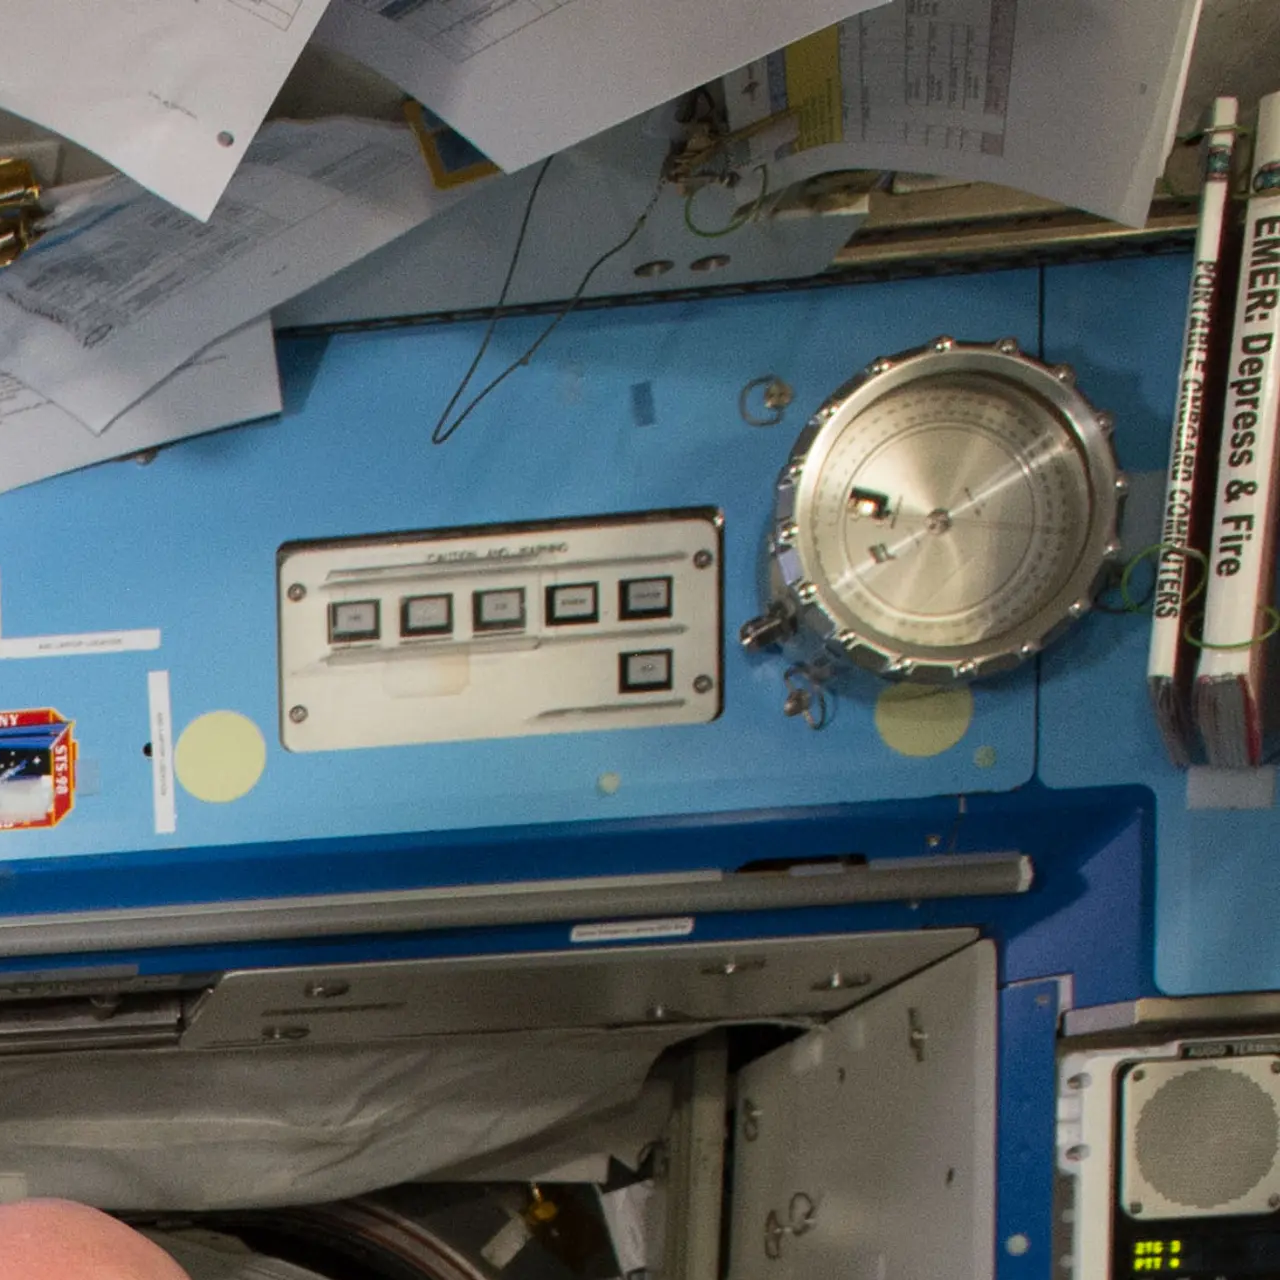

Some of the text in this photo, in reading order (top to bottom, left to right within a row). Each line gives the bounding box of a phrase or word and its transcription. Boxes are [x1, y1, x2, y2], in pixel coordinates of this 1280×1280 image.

[1215, 215, 1280, 578] EMER: Depress & Fire
[53, 744, 70, 795] STS-98
